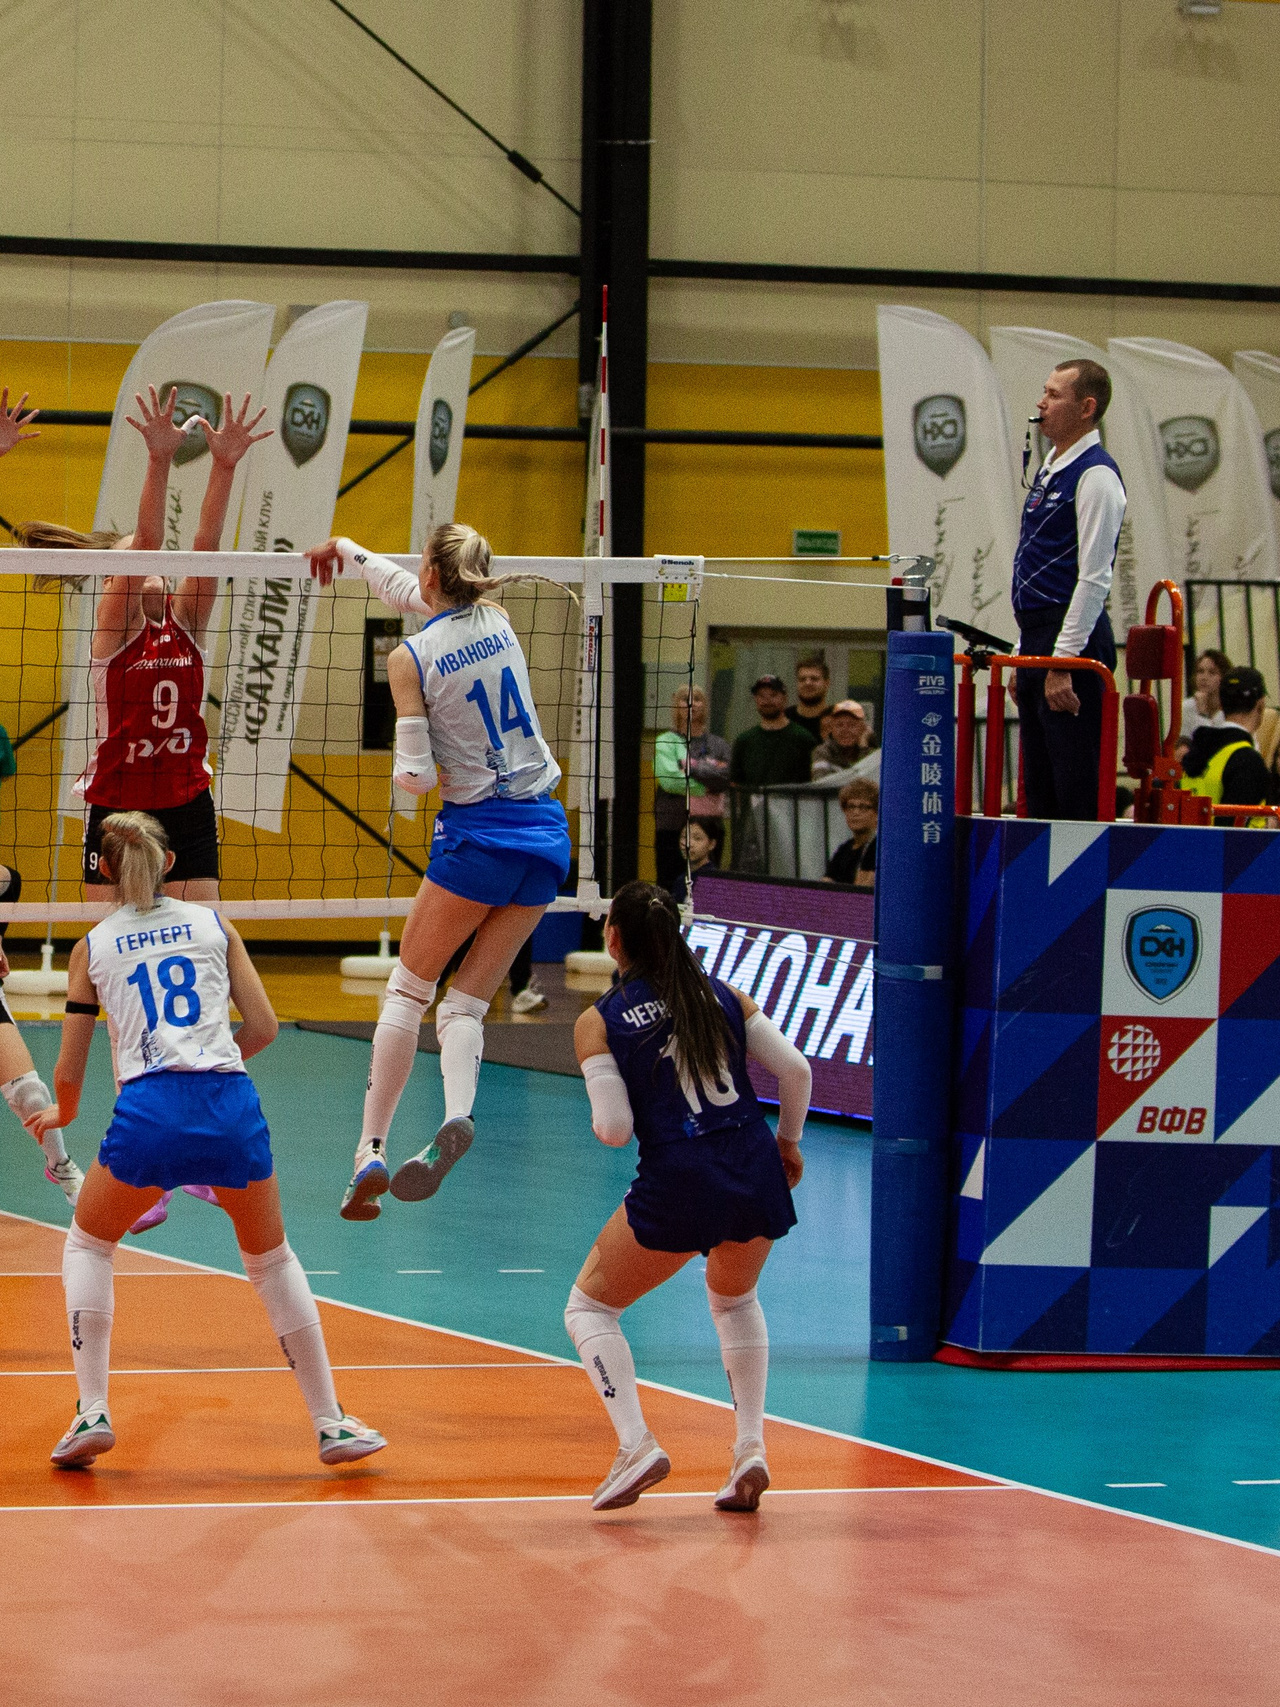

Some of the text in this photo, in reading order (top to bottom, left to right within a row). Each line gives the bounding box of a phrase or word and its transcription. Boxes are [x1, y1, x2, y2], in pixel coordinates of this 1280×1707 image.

[259, 490, 273, 530] КЛУБ
[245, 537, 293, 744] «САХАЛИ»
[435, 629, 515, 677] ИВАНОВА К.
[152, 680, 178, 729] 9
[465, 666, 535, 750] 14
[921, 734, 943, 844] 金陵体育
[89, 853, 98, 870] 9
[115, 923, 193, 954] ГЕРГЕРТ
[127, 955, 201, 1034] 18
[1136, 1106, 1207, 1135] ВФВ
